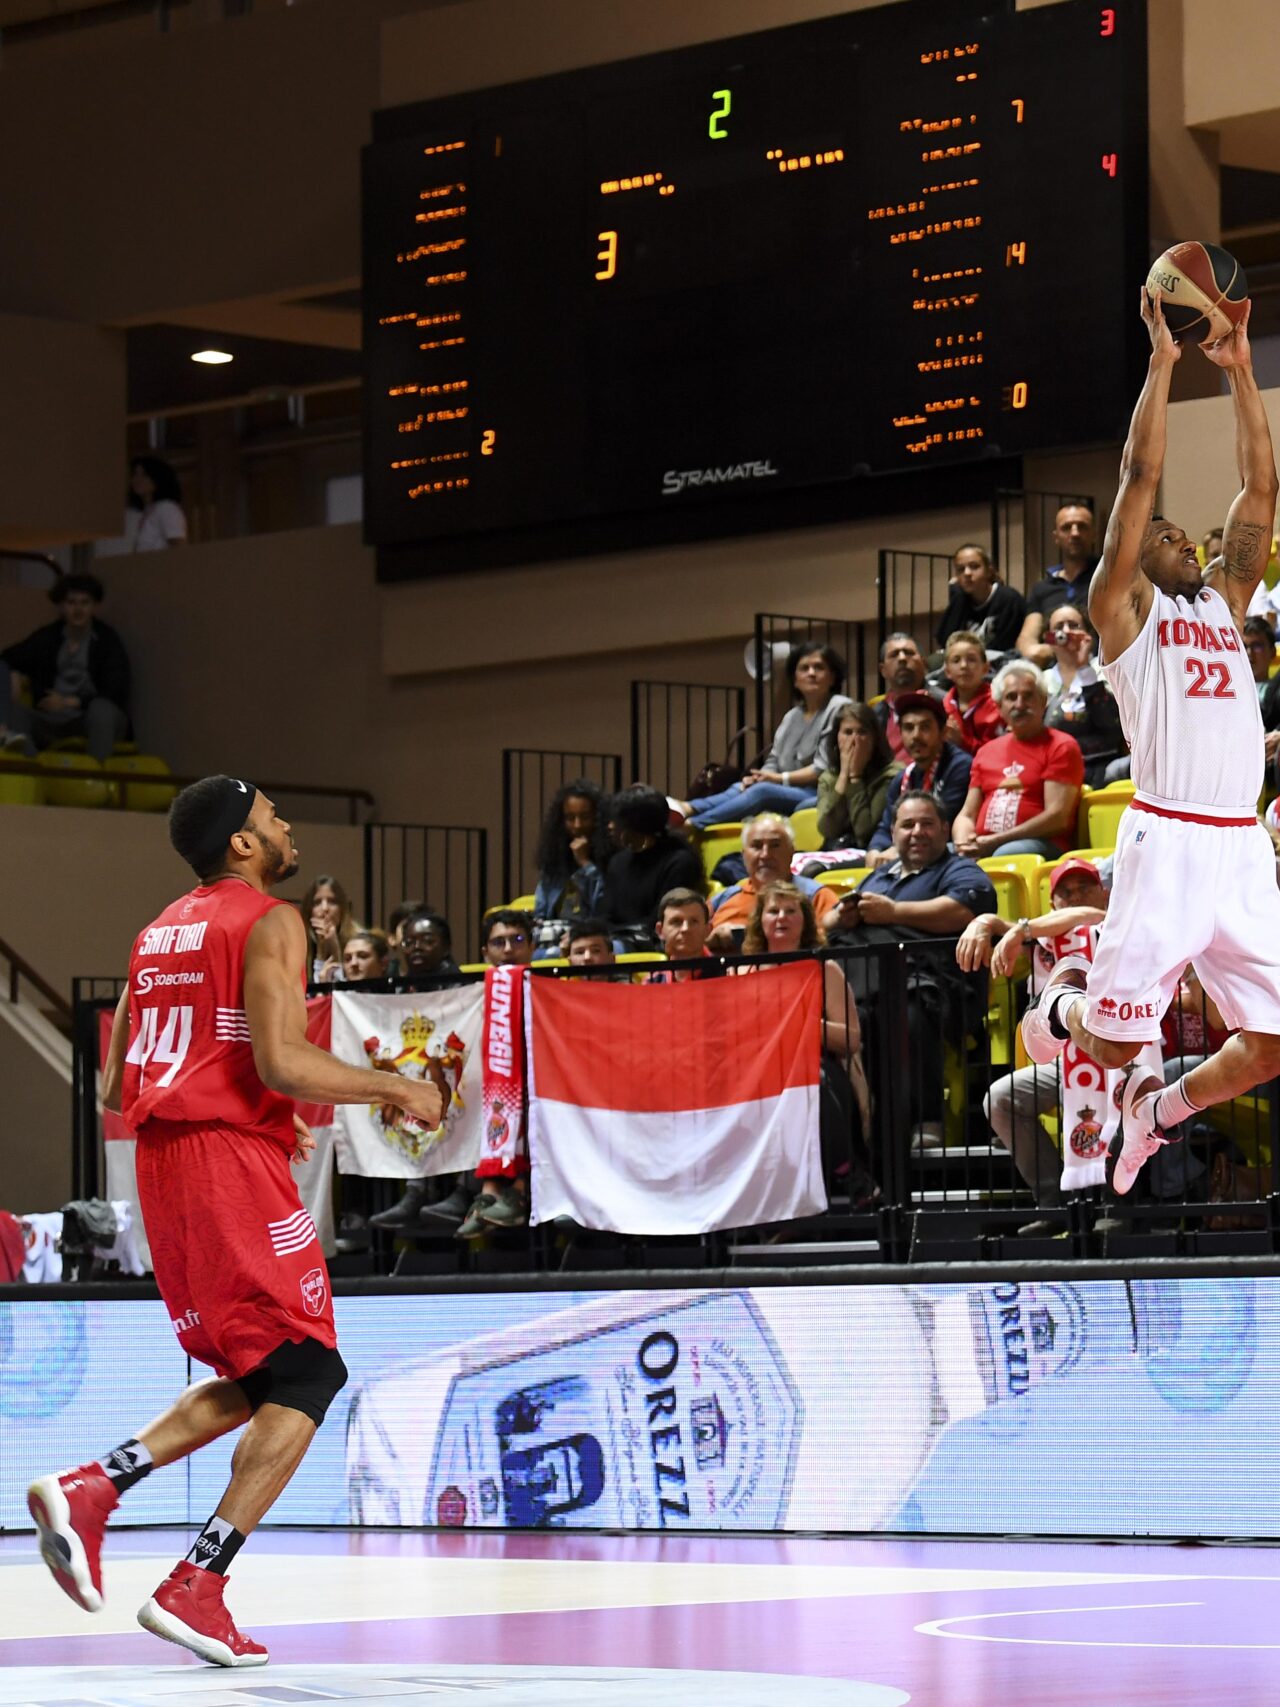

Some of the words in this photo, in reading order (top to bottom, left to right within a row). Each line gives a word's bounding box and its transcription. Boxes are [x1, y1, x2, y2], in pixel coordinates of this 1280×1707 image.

[1100, 9, 1115, 36] 3
[709, 89, 731, 139] 2
[1011, 99, 1024, 123] 7
[1102, 153, 1117, 177] 4
[595, 231, 617, 280] 3
[481, 430, 495, 455] 2
[661, 460, 778, 494] STRAMATEL
[1184, 656, 1237, 699] 22
[138, 920, 208, 956] SANFORD
[125, 1005, 193, 1095] 44
[196, 1536, 222, 1556] BIG
